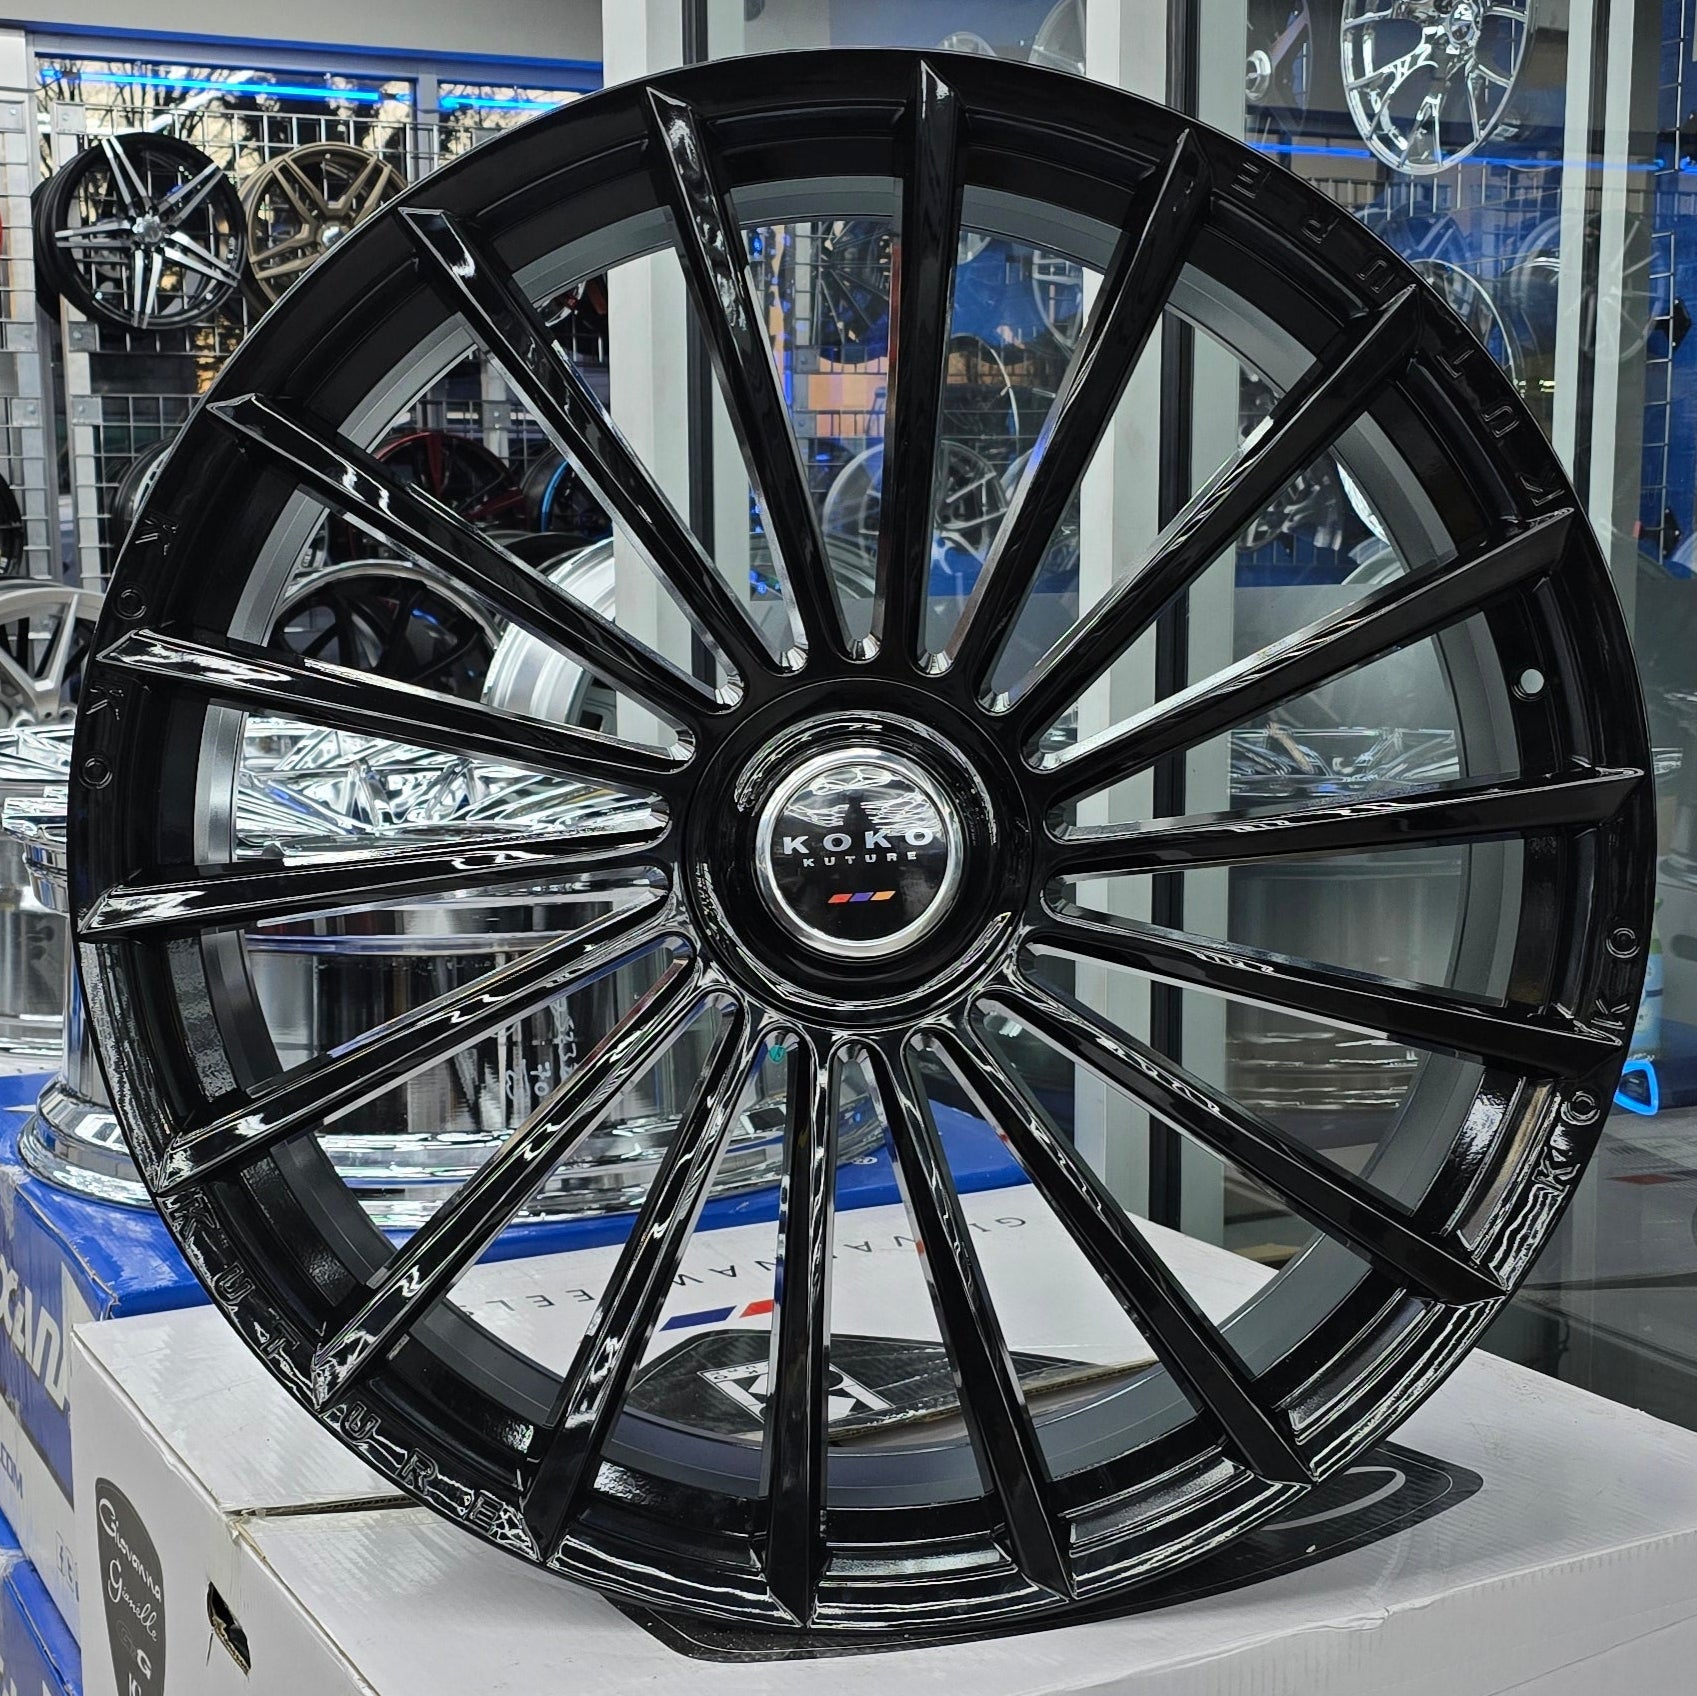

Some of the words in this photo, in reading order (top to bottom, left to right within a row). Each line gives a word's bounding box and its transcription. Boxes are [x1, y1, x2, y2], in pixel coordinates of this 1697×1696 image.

[782, 829, 933, 855] KOKO
[802, 851, 917, 867] KUTURE
[99, 1498, 161, 1603] Giovanna
